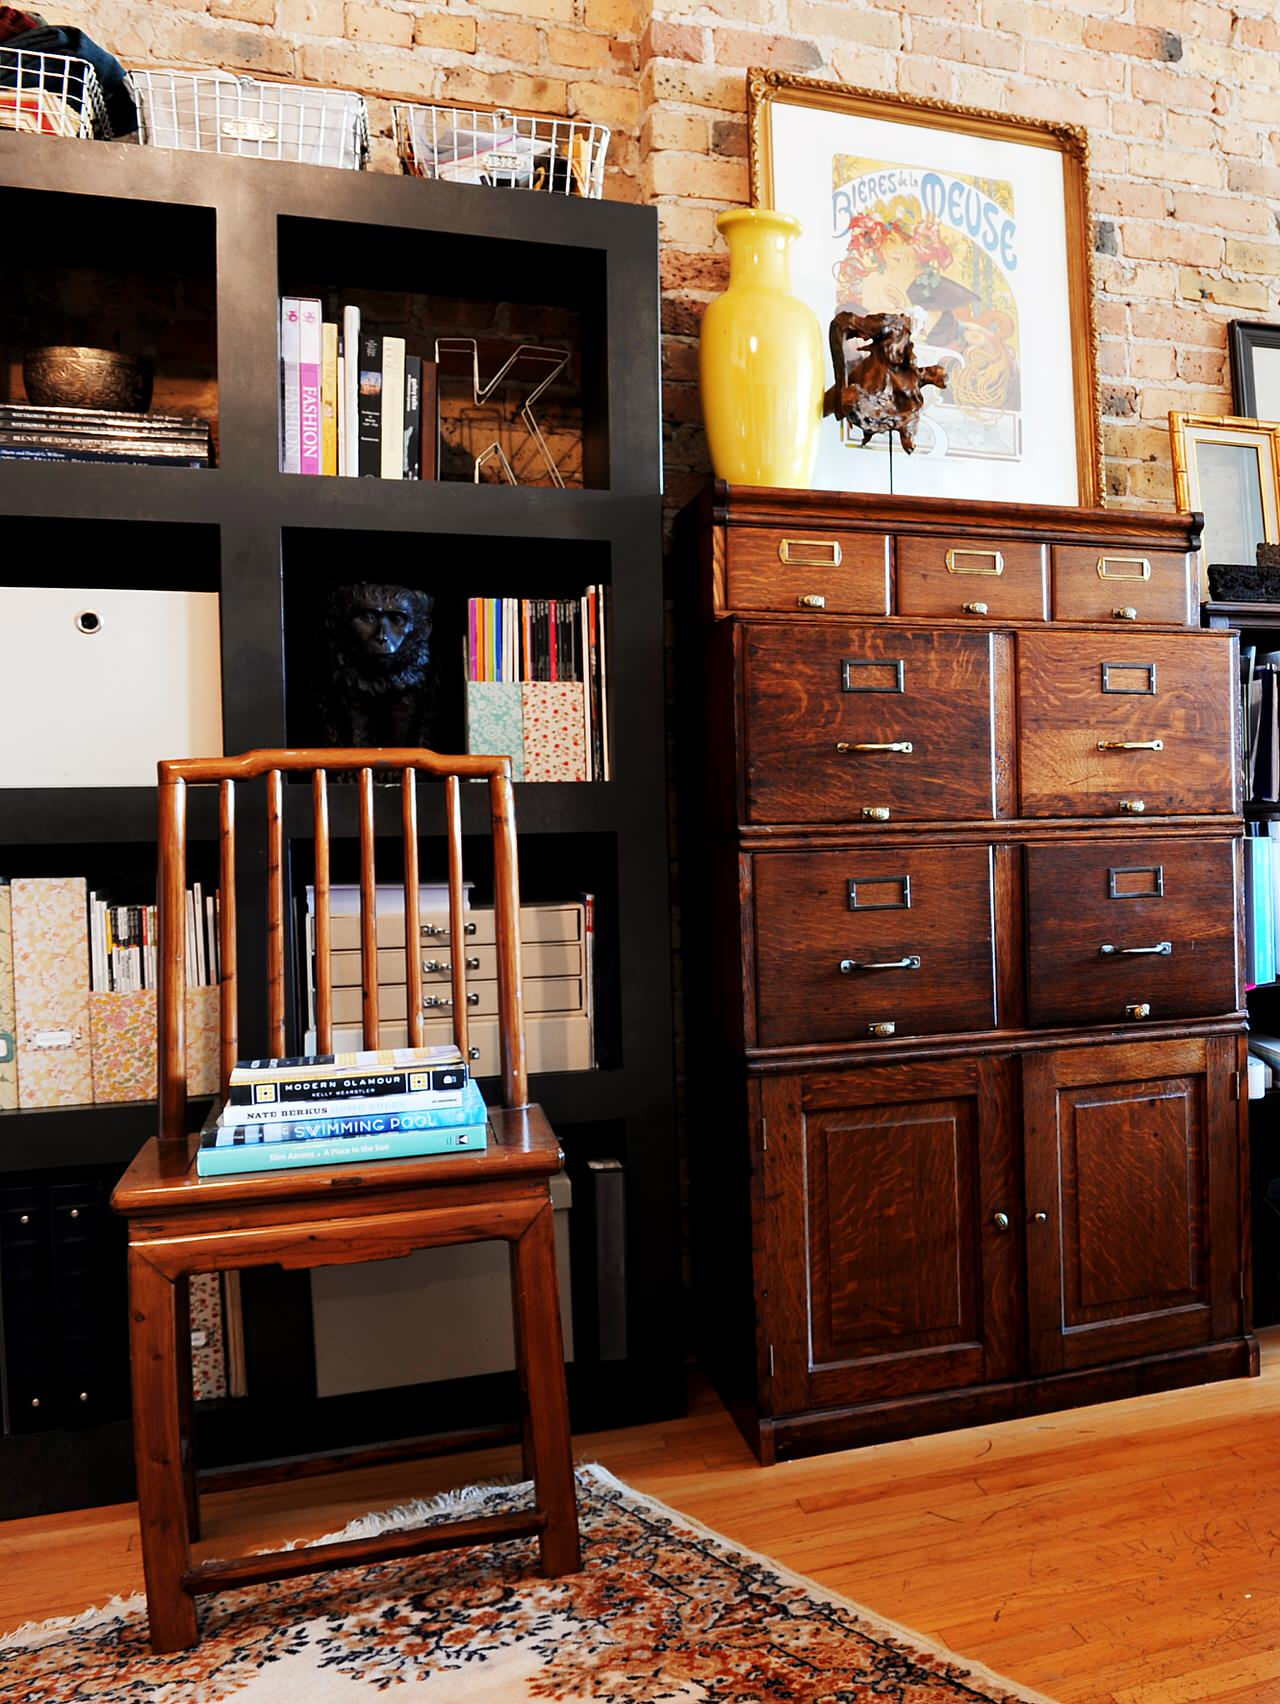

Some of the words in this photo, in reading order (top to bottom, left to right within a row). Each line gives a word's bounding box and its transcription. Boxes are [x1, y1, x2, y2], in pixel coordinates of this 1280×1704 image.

[898, 171, 909, 188] de
[910, 173, 919, 188] la
[920, 172, 1018, 272] MEUSE
[302, 385, 318, 460] FASHION
[284, 1081, 337, 1092] MODERN
[343, 1076, 401, 1088] GLAMOUR
[246, 1111, 278, 1120] NATE
[281, 1106, 329, 1118] BERKUS
[293, 1119, 385, 1139] SWIMMING
[390, 1112, 438, 1130] POOL
